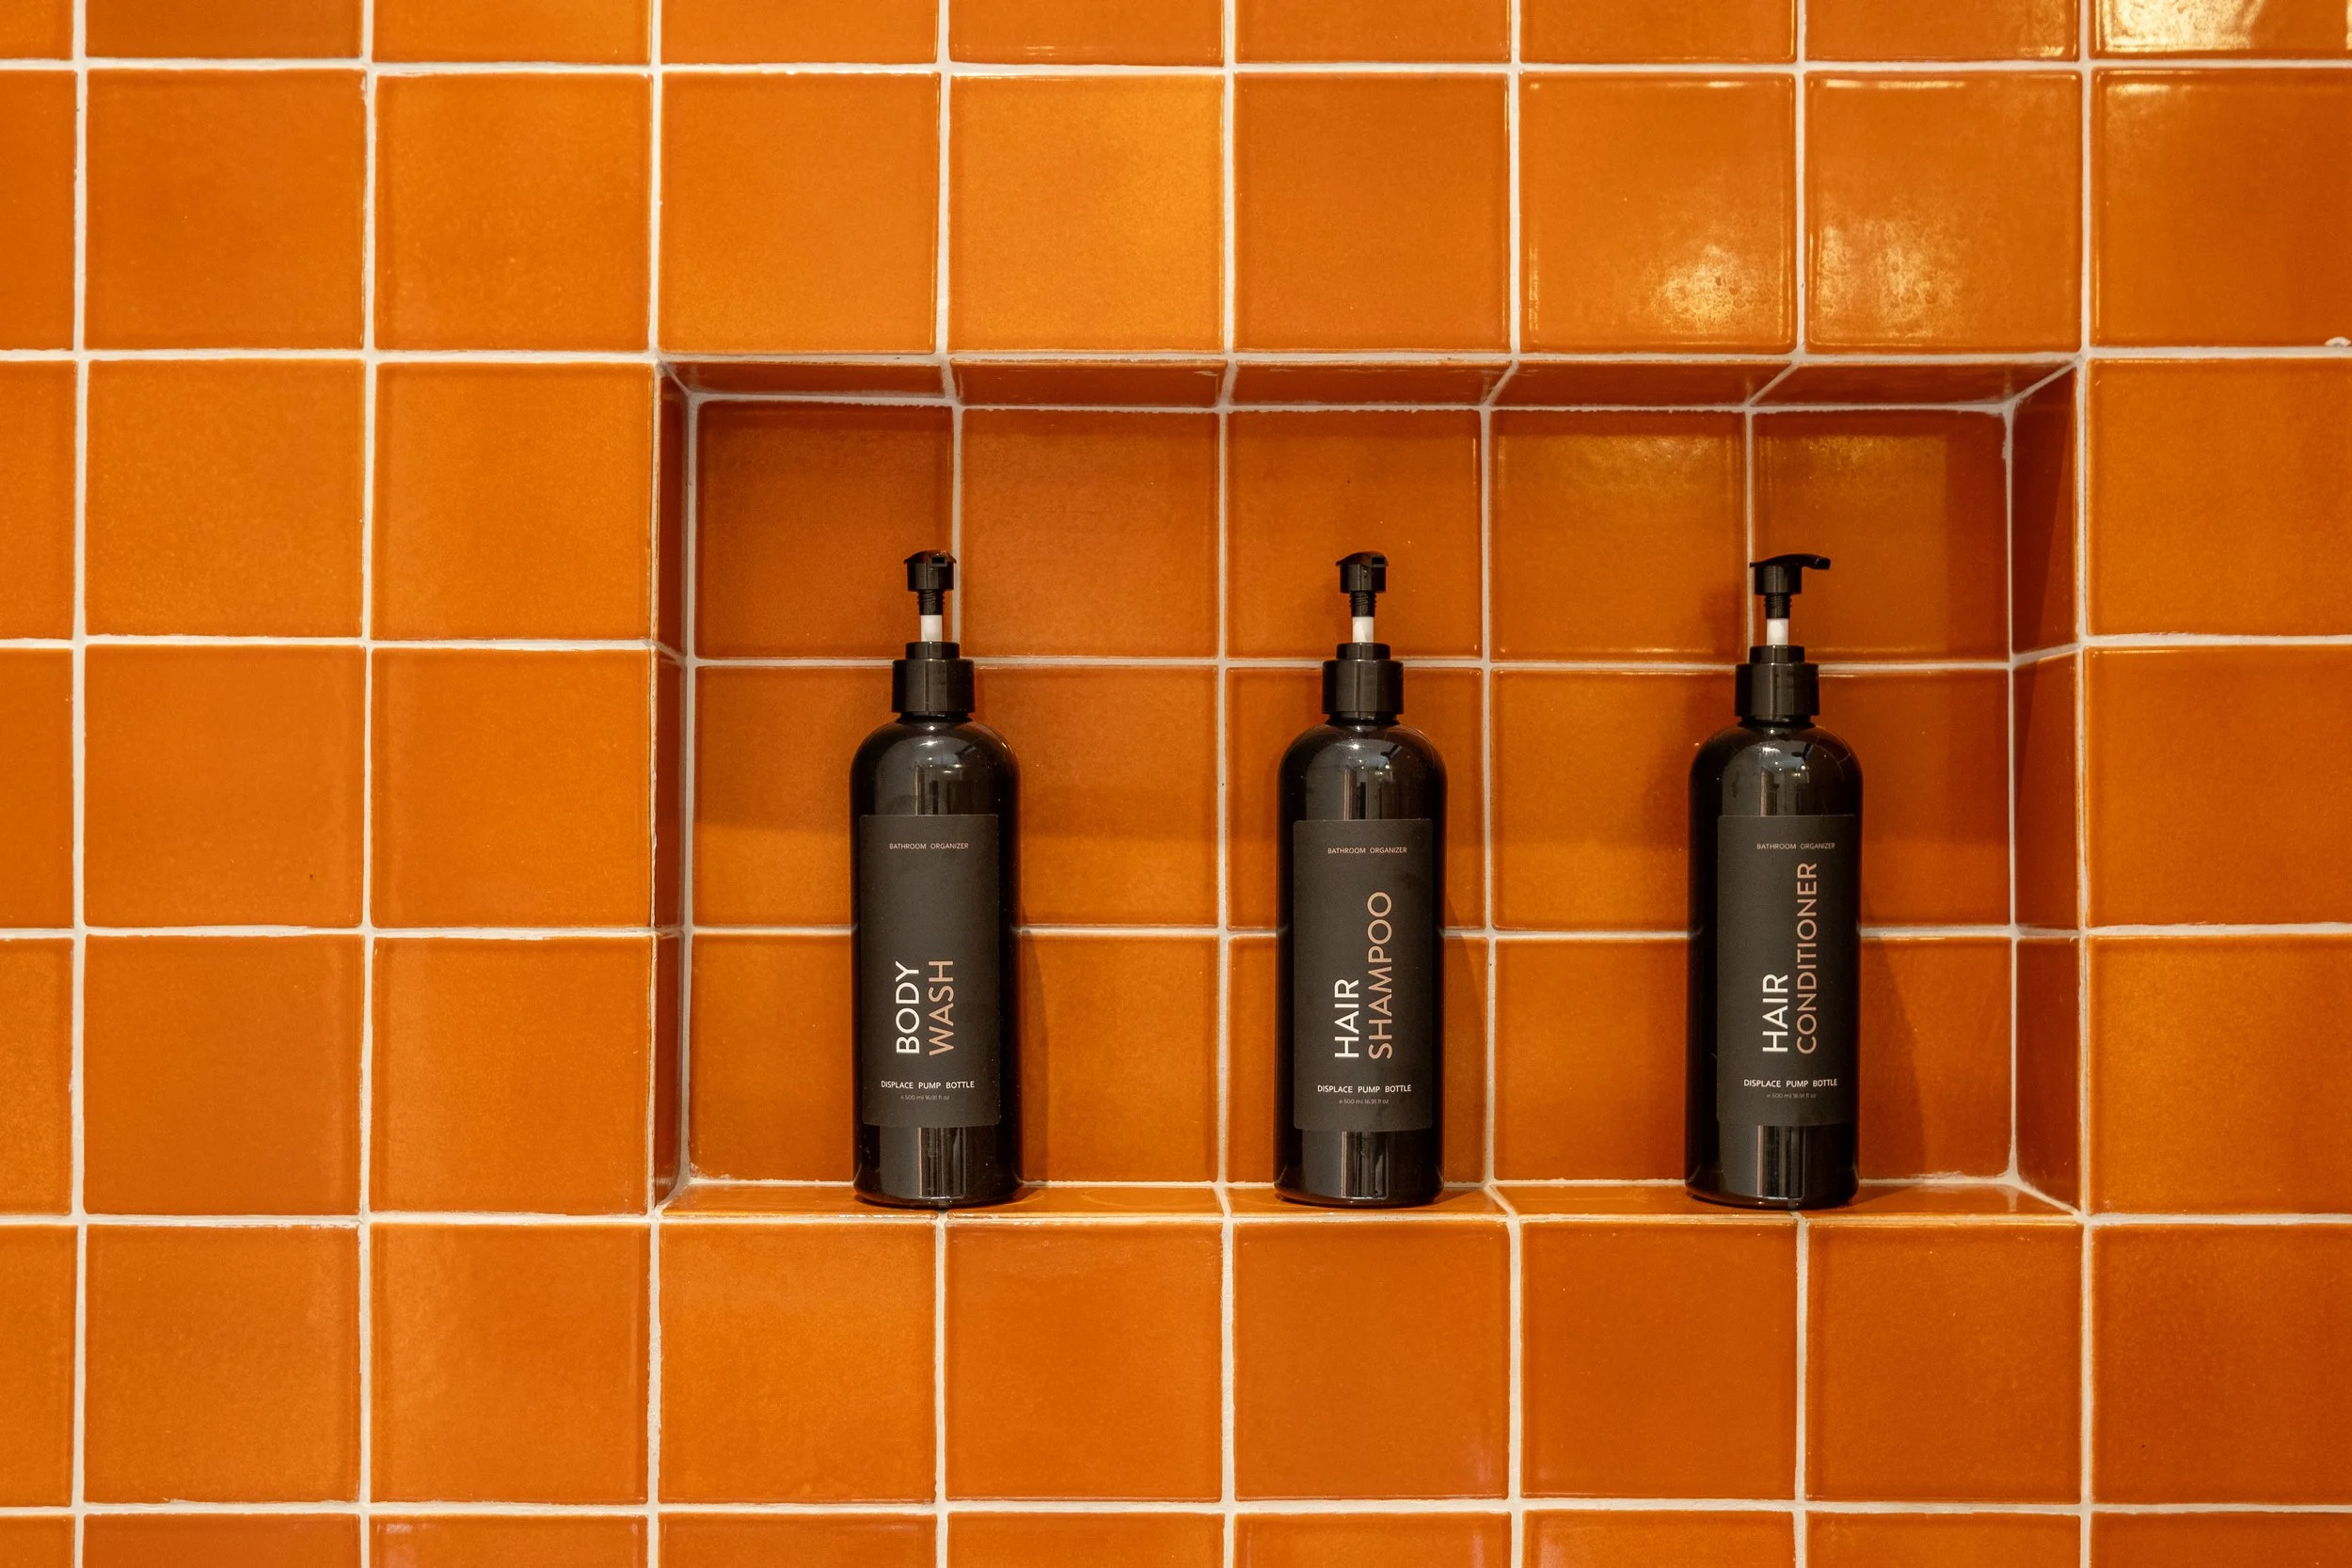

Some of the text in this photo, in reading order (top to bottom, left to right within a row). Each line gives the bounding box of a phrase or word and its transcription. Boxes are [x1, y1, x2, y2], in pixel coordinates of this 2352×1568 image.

[1367, 892, 1392, 1060] SHAMPOO
[1796, 863, 1818, 1054] CONDITIONER
[895, 960, 920, 1054] BODY
[928, 960, 955, 1056] WASH
[1334, 978, 1359, 1058] HAIR
[1762, 974, 1788, 1053] HAIR
[881, 1080, 914, 1089] DISPLACE
[946, 1080, 975, 1088] BOTTLE
[1317, 1085, 1353, 1093] DISPLACE
[1385, 1084, 1412, 1093] BOTTLE
[1743, 1078, 1837, 1088] DISPLACE PUMP BOTTLE
